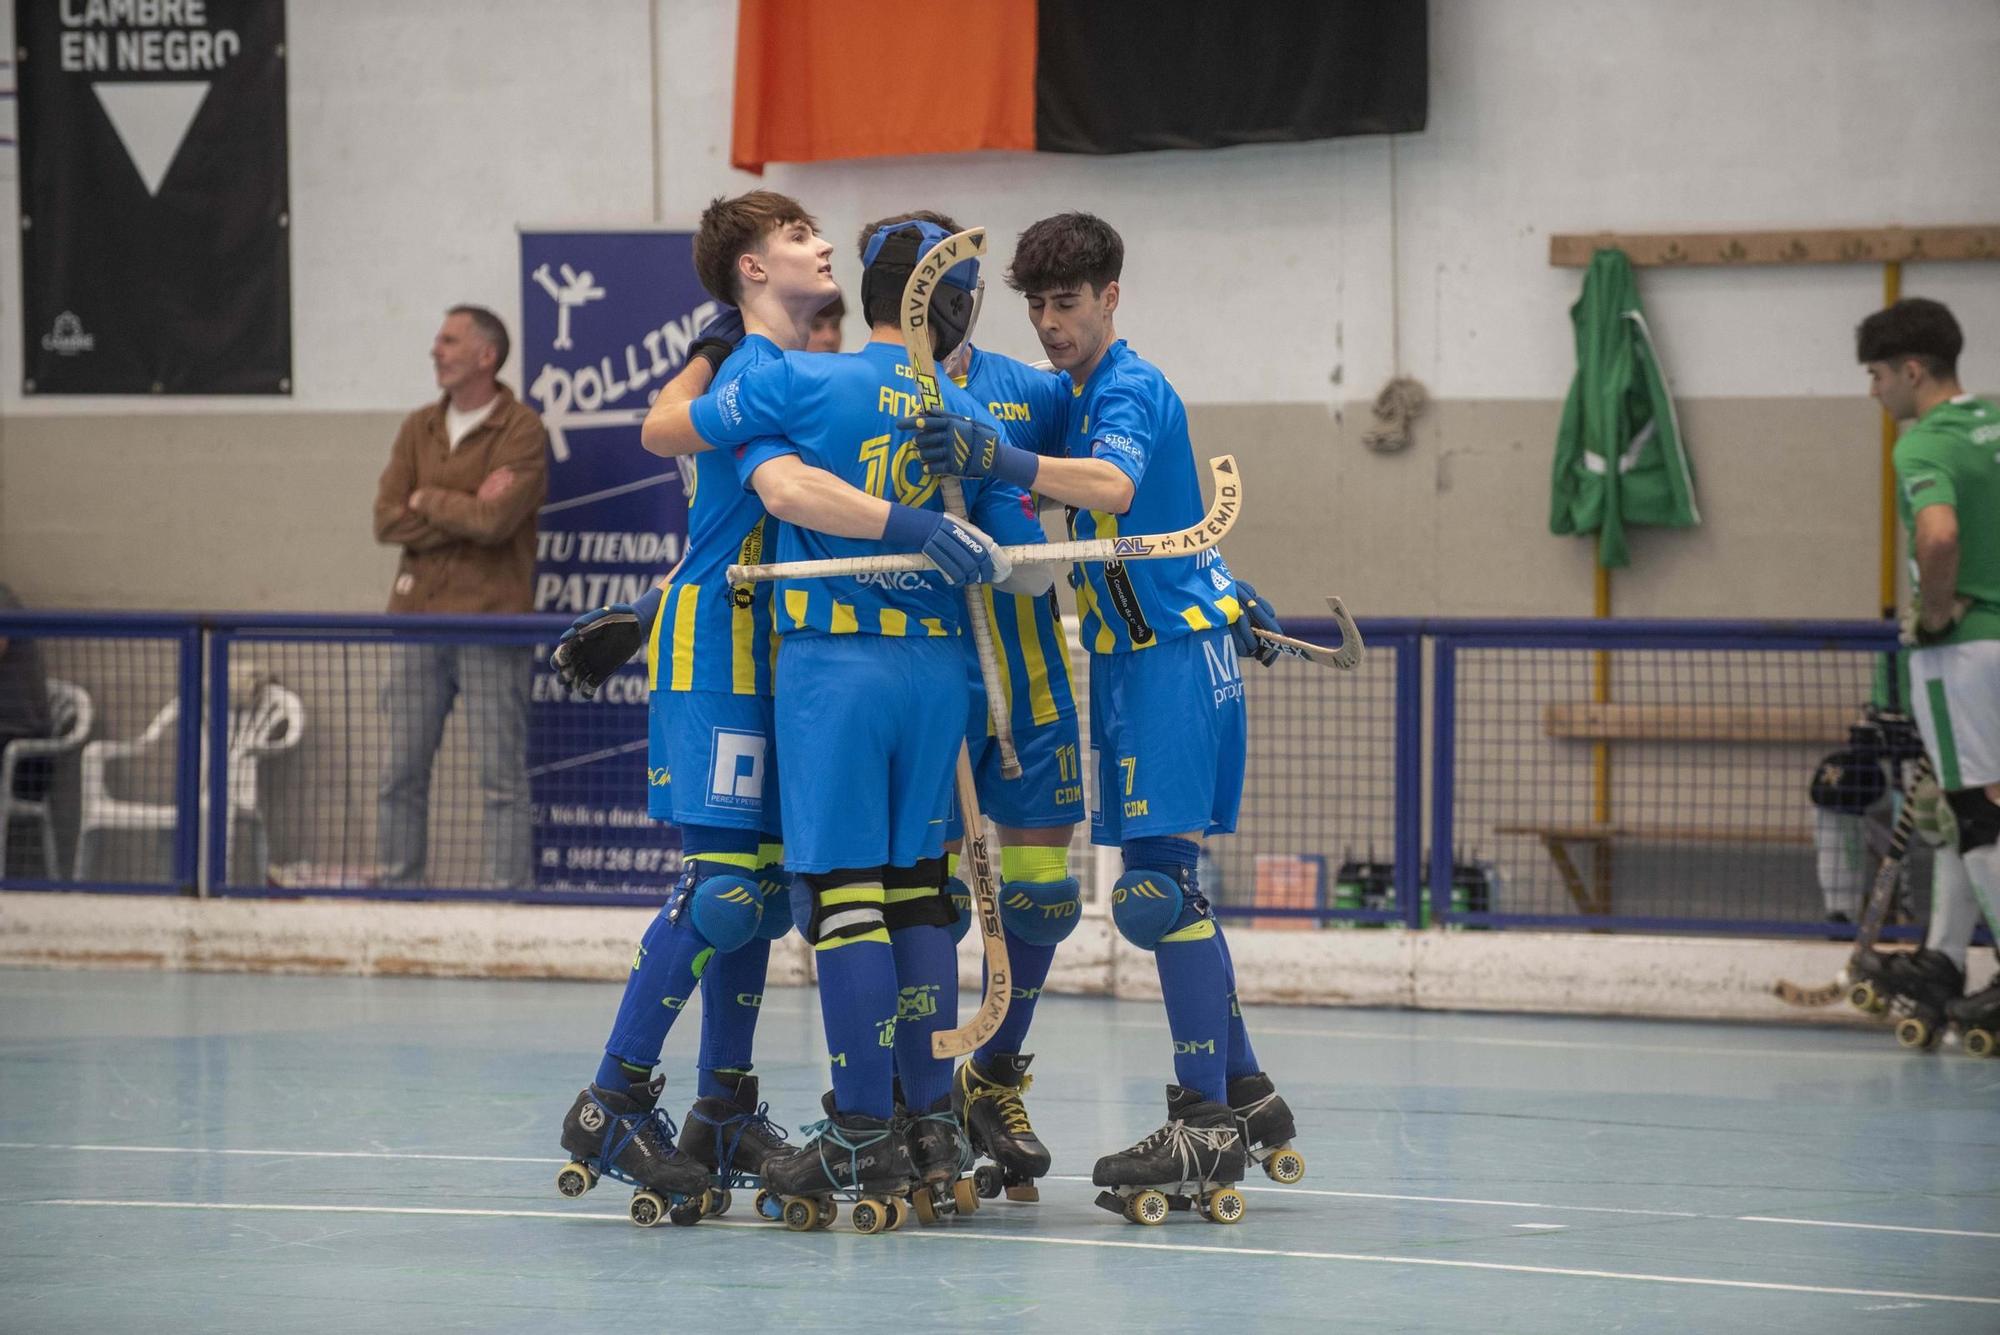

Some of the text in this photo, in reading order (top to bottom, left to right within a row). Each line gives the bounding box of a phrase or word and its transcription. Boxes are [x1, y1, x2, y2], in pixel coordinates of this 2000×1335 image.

[60, 0, 207, 27] CAMBRE
[60, 29, 241, 71] EN NEGRO
[895, 363, 917, 379] CD
[988, 401, 1031, 421] CDM
[859, 434, 941, 508] 19
[536, 531, 575, 562] TU
[577, 531, 680, 563] TIENDA
[1056, 743, 1077, 782] 11
[1120, 756, 1136, 796] 7
[1055, 786, 1082, 805] CDM
[1124, 799, 1148, 818] CDM
[973, 837, 1002, 937] SUPER
[1037, 900, 1076, 919] TVD
[662, 996, 687, 1010] CD
[736, 992, 763, 1007] CD
[1173, 1039, 1215, 1055] DM
